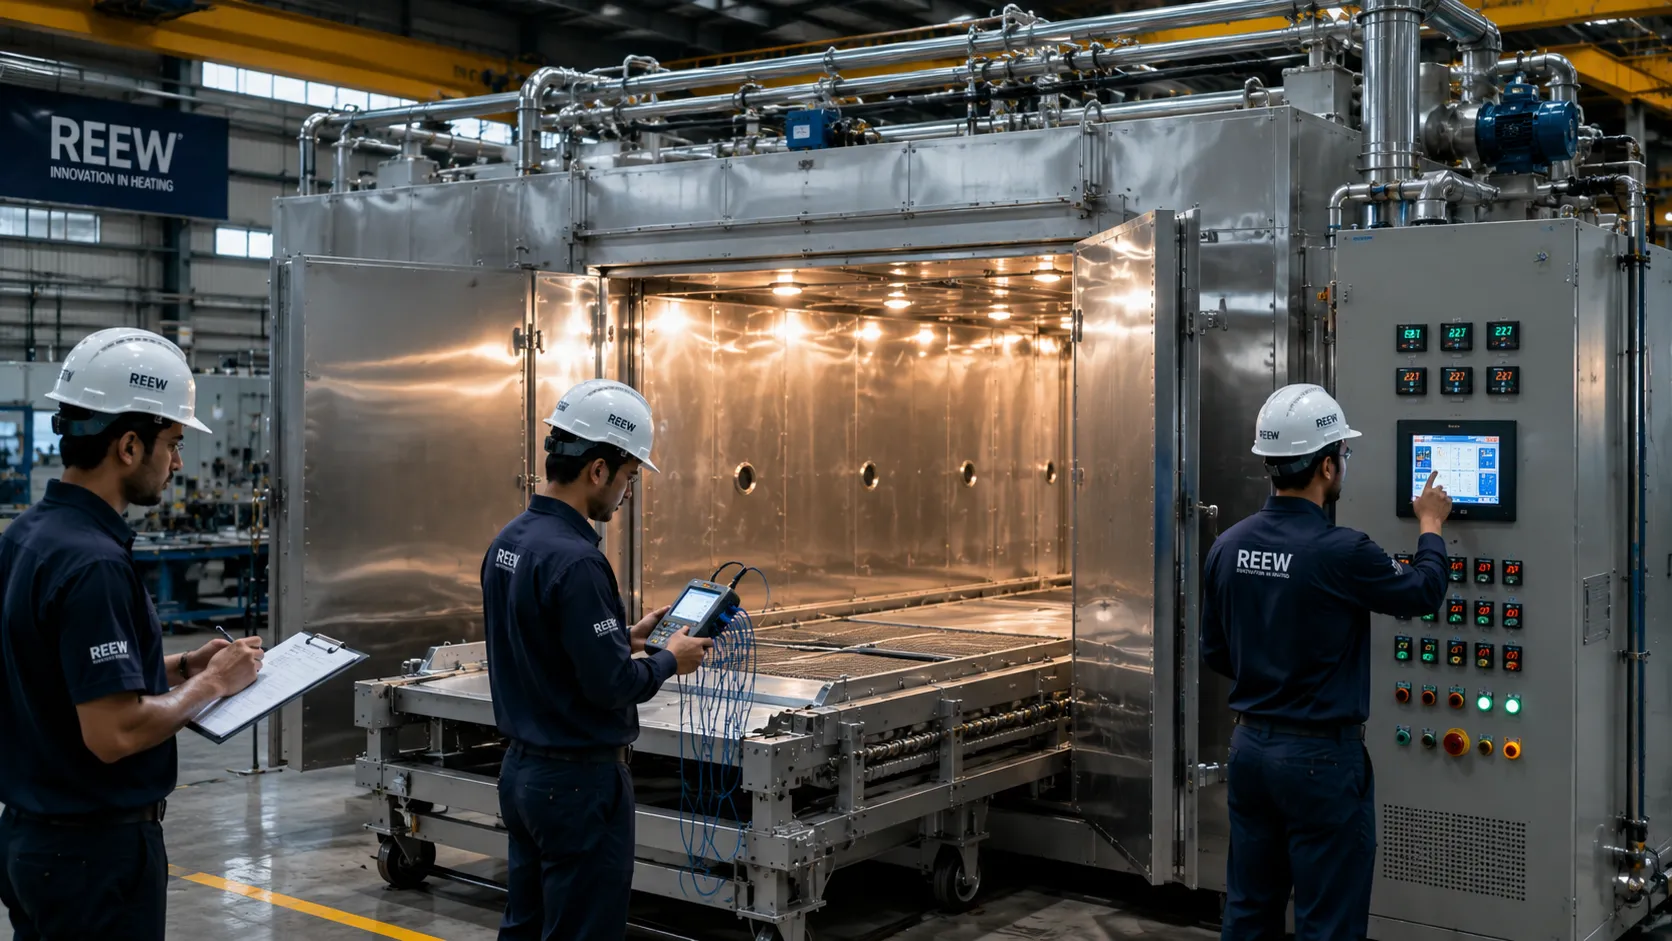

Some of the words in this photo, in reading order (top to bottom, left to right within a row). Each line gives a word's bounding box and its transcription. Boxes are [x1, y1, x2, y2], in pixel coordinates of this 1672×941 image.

[51, 115, 177, 174] REEW
[50, 166, 115, 185] INNOVATION
[117, 174, 129, 187] IN
[130, 175, 174, 192] HEATING
[1495, 326, 1513, 336] 227
[129, 372, 168, 391] REEW
[607, 413, 637, 432] REEW
[1237, 549, 1294, 572] REEW
[90, 640, 128, 660] REEW
